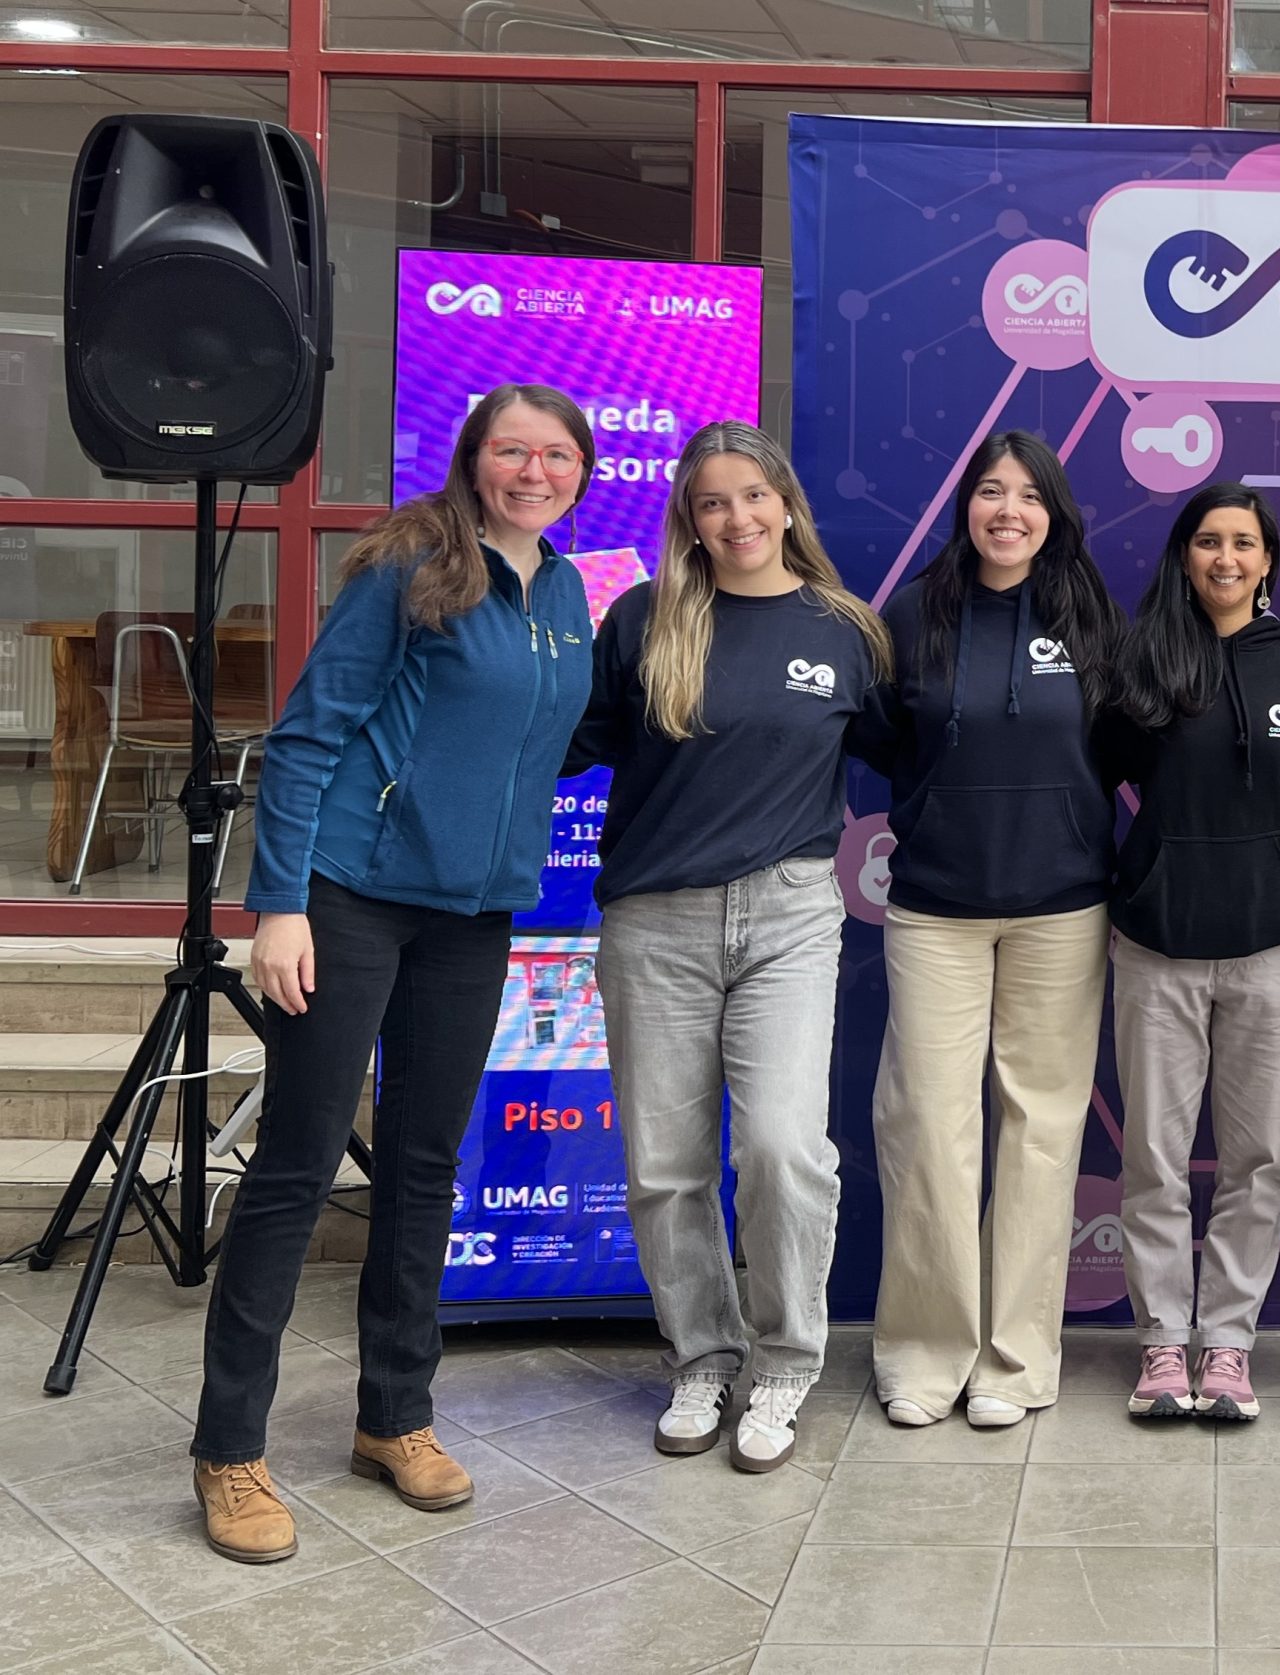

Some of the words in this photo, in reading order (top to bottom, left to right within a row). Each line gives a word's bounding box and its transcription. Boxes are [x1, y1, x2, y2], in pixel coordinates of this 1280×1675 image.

[516, 288, 585, 302] CIENCIA
[514, 301, 587, 315] ABIERTA
[649, 295, 733, 319] UMAG
[1003, 317, 1045, 327] CIENCIA
[551, 796, 577, 814] 20
[582, 795, 609, 814] de
[505, 1101, 583, 1132] Piso
[596, 1101, 612, 1130] 1
[483, 1185, 568, 1209] UMAG
